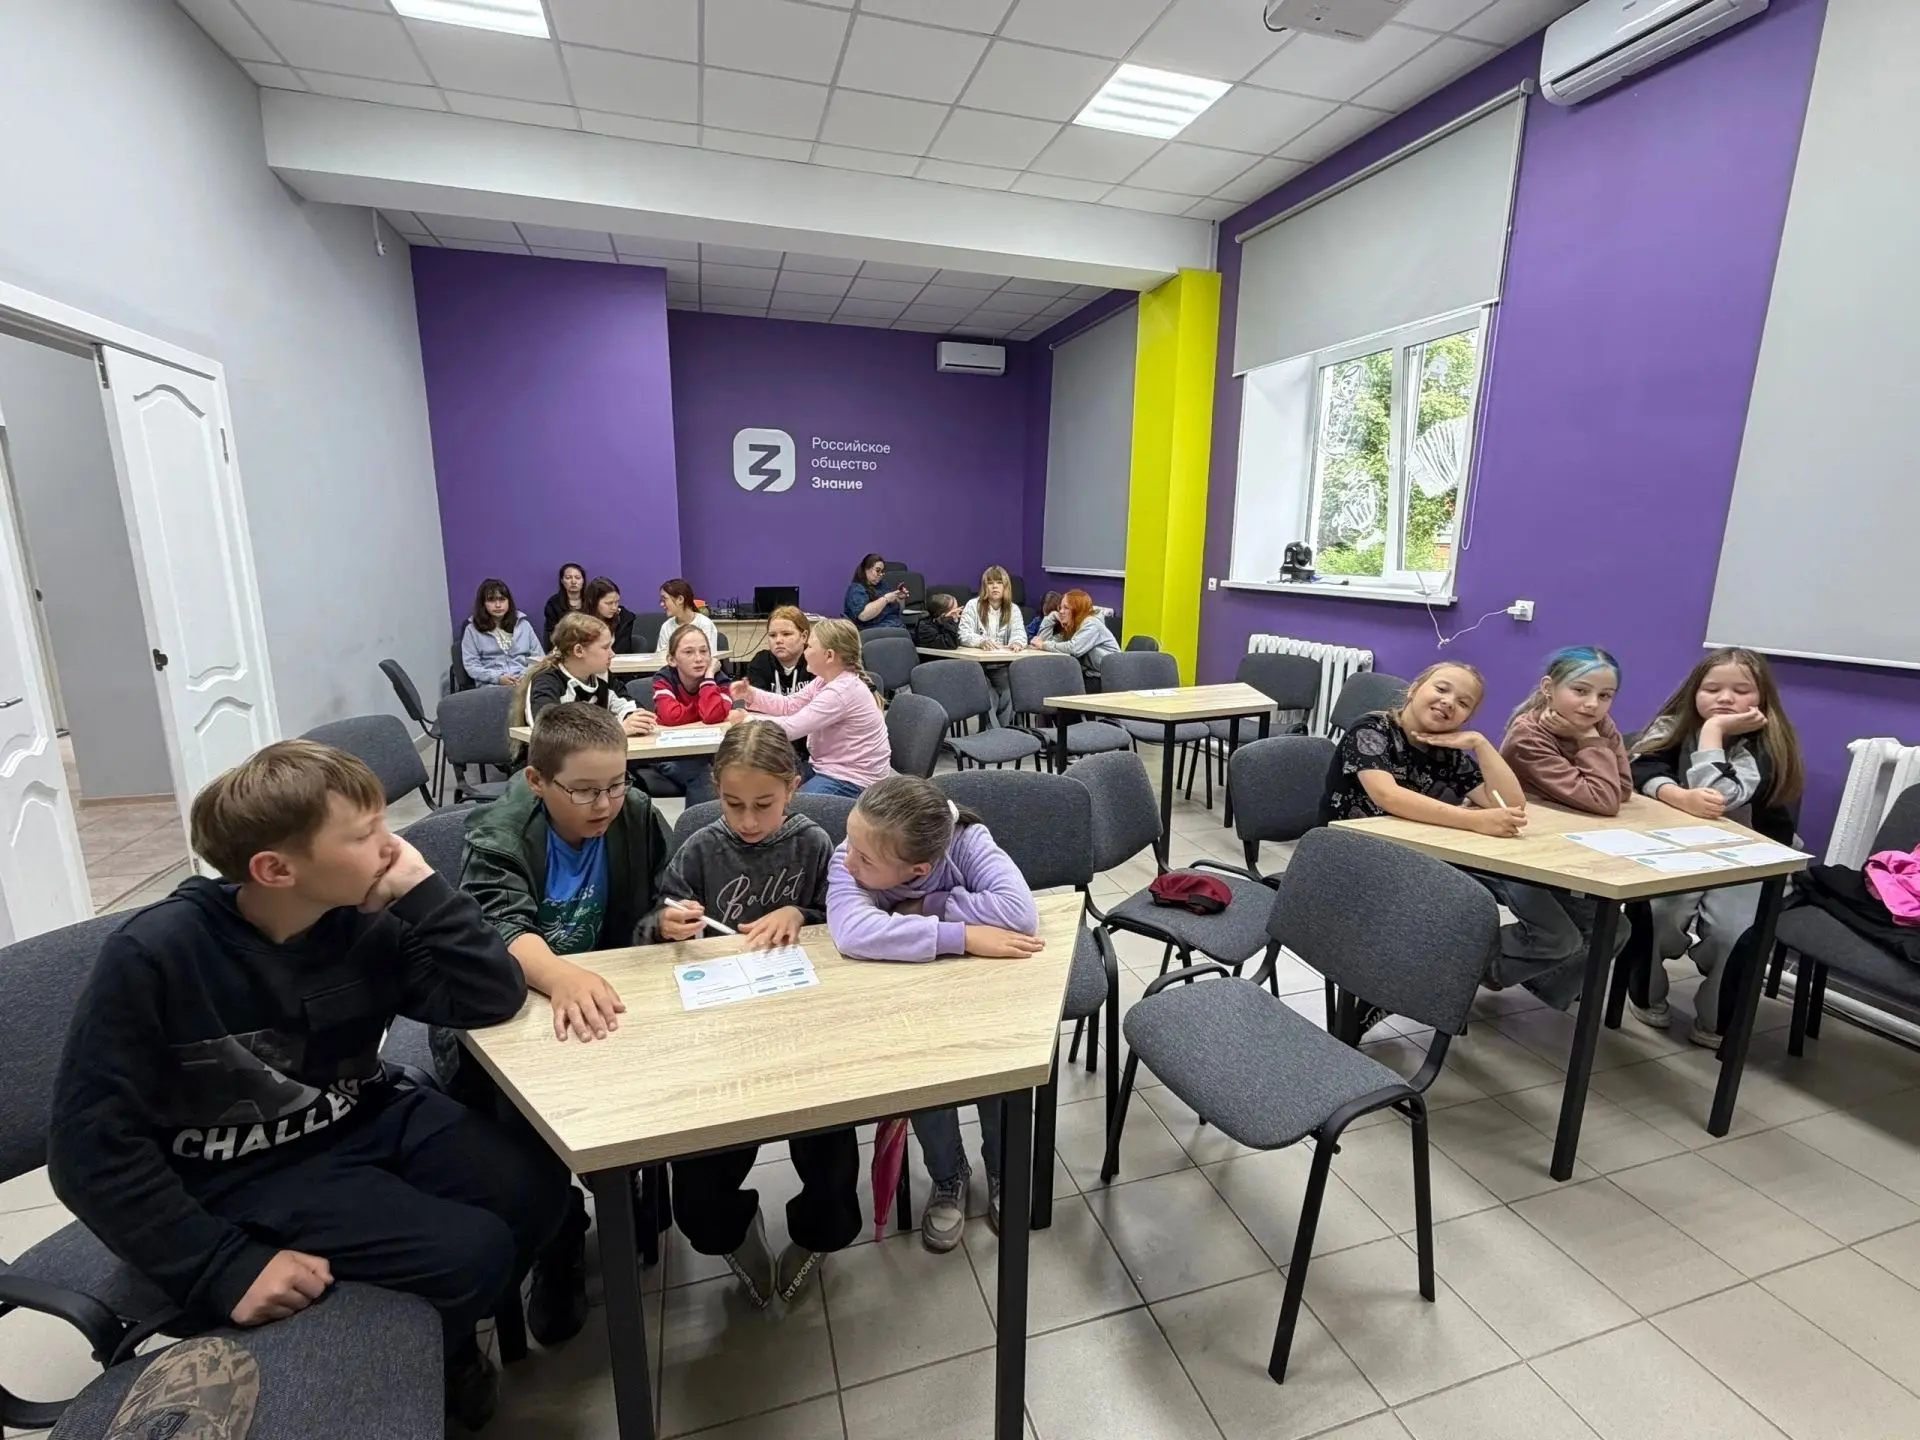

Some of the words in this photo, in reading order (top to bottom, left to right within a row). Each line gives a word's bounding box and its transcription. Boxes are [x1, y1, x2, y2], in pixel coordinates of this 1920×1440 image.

[811, 437, 891, 454] Российское
[811, 456, 877, 471] общество
[811, 477, 863, 490] Знание
[716, 868, 805, 923] Ballet
